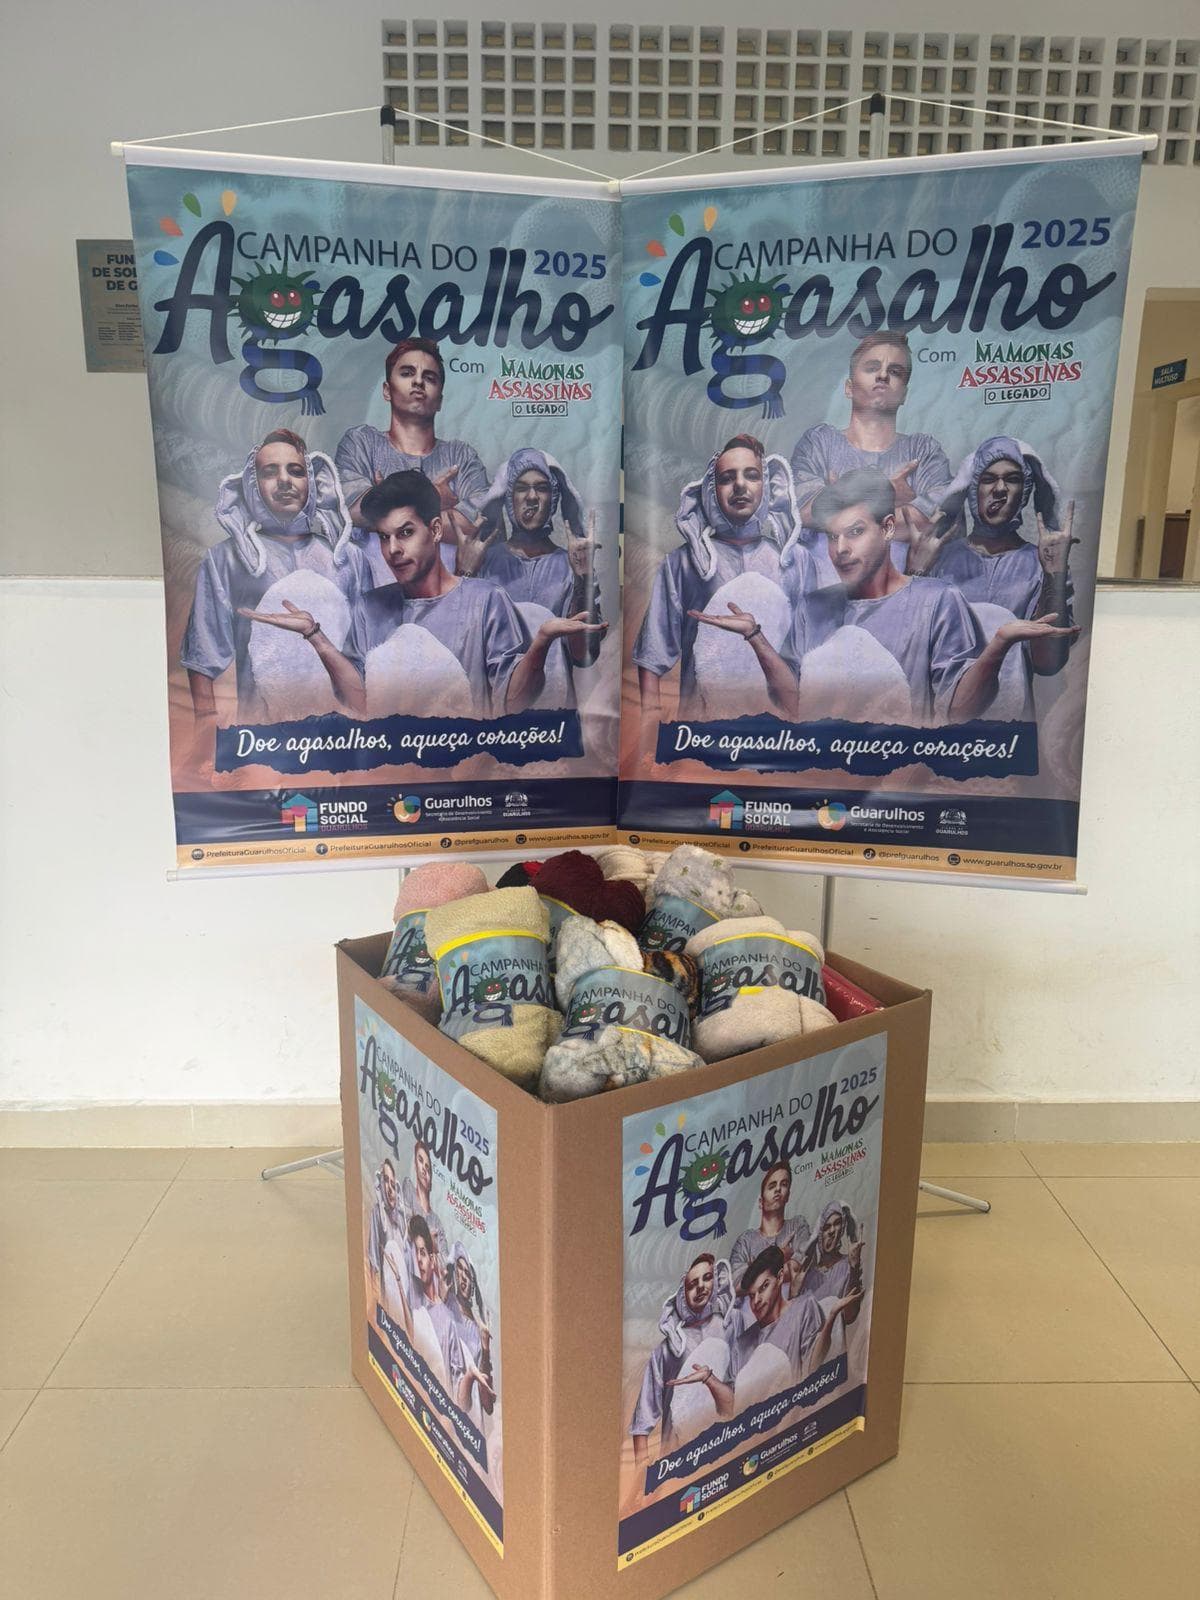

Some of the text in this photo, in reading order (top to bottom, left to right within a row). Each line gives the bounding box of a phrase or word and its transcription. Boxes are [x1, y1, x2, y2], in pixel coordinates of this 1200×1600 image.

[1020, 216, 1112, 250] 2025
[236, 230, 478, 273] CAMPANHA DO
[715, 227, 958, 271] CAMPANHA DO
[92, 267, 111, 278] DE
[533, 248, 608, 280] 2025
[106, 280, 126, 291] DE
[151, 219, 615, 417] Agasalho
[630, 222, 1118, 420] Agasalho
[917, 346, 957, 364] Com
[975, 338, 1075, 364] MAMONAS
[449, 357, 485, 375] Com
[500, 355, 586, 382] MAMONAS
[956, 359, 1083, 389] ASSASSINAS
[488, 379, 593, 402] ASSASSINAS
[999, 388, 1048, 402] LEGADO
[525, 402, 566, 416] LEGADO
[236, 721, 565, 763] Doe agasalhos, aqueça corações!
[673, 725, 1019, 765] Doe agasalhos, aqueça corações!
[320, 801, 368, 815] FUNDO
[424, 795, 493, 810] Guarulhos
[744, 801, 792, 815] FUNDO
[850, 805, 925, 822] Guarulhos
[320, 814, 368, 825] SOCIAL
[744, 814, 791, 826] SOCIAL
[206, 846, 307, 858] PrefeituraGuarulhosOficial
[330, 840, 432, 853] PrefeituraGuarulhosOficial
[752, 843, 854, 856] PrefeituraGuarulhosOficial
[962, 858, 1063, 870] www.guarulhos.sp.gov.br
[653, 910, 699, 937] CAMPAN
[704, 953, 802, 976] CAMPANHA DO
[574, 986, 677, 1015] CAMPANHA DO
[376, 1045, 442, 1117] CAMPANHA DO
[840, 1066, 878, 1096] 2025
[360, 1034, 493, 1197] Agasalho
[684, 1092, 813, 1153] CAMPANHA DO
[459, 1119, 490, 1157] 2025
[820, 1137, 864, 1165] MAMONAS
[629, 1081, 880, 1242] Agasalho
[794, 1161, 813, 1175] Com
[814, 1146, 868, 1182] ASSASSINAS
[657, 1458, 685, 1480] Doe
[685, 1421, 747, 1467] agasalhos,
[749, 1398, 792, 1430] aqueça
[791, 1362, 840, 1402] corações!
[760, 1432, 798, 1460] Guarulhos
[701, 1472, 730, 1493] FUNDO
[701, 1482, 729, 1501] SOCIAL
